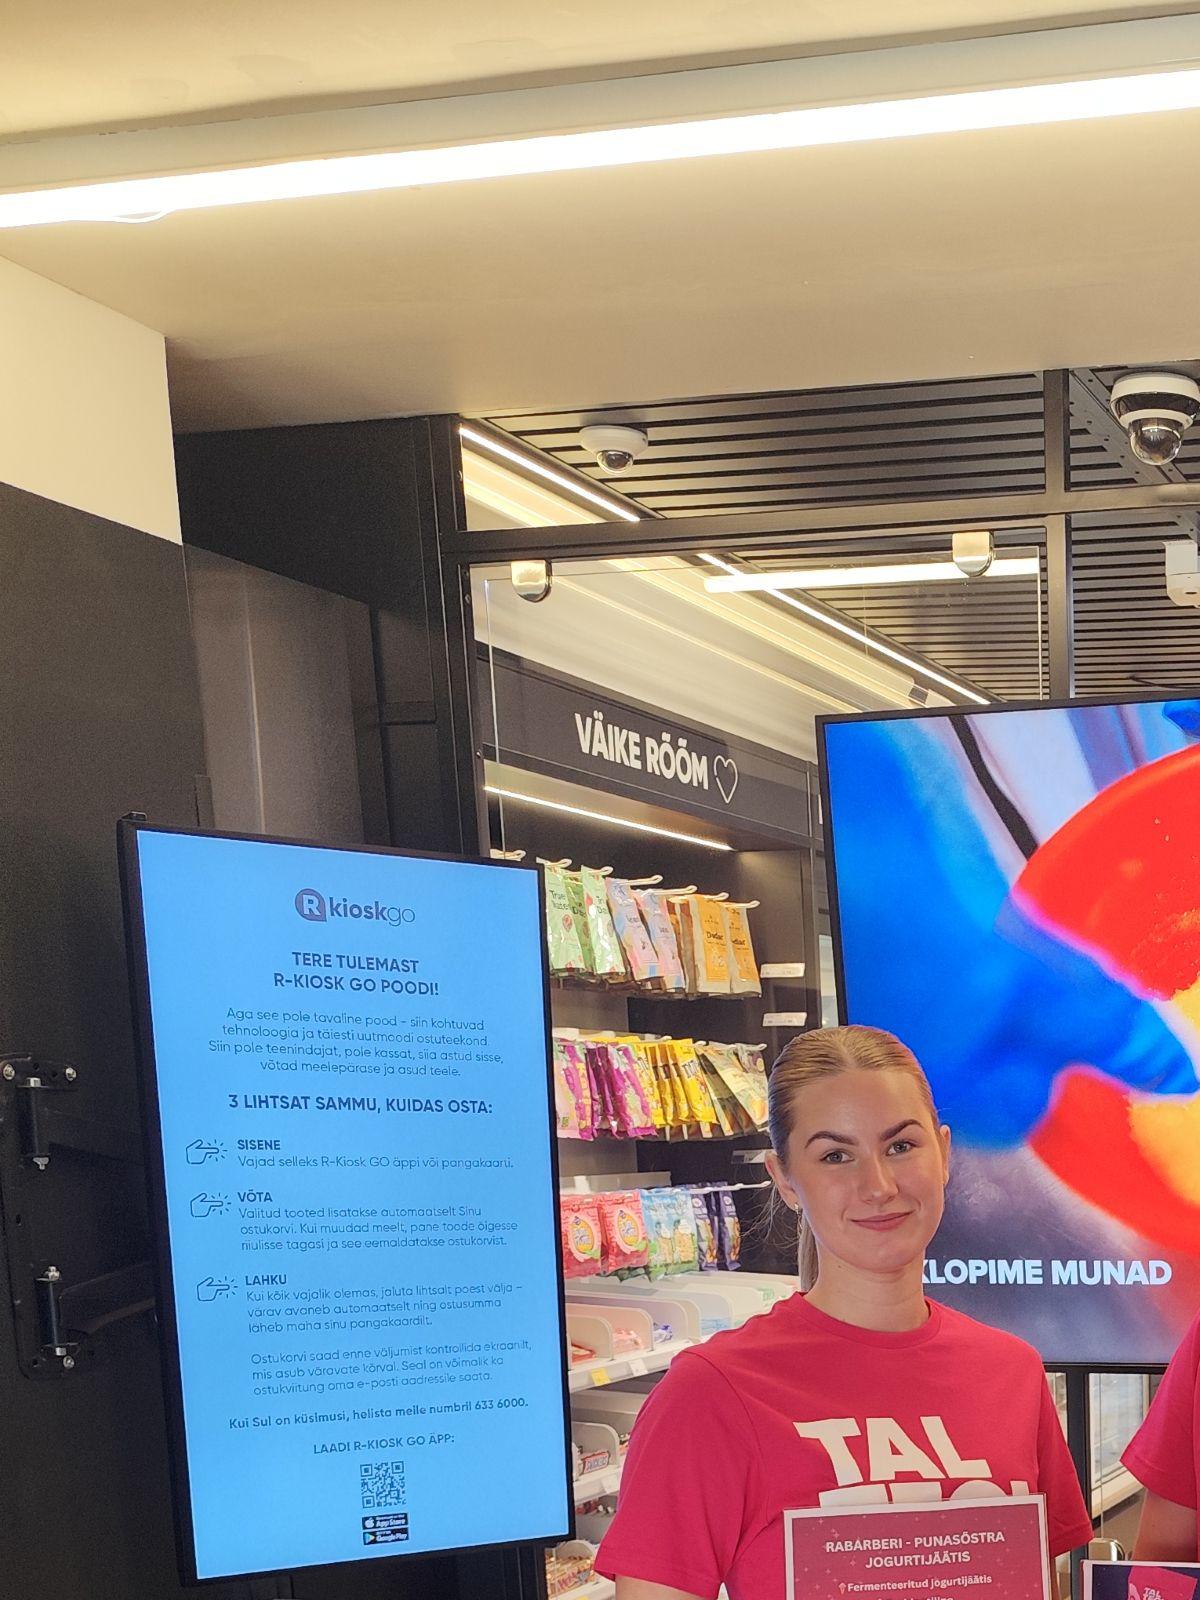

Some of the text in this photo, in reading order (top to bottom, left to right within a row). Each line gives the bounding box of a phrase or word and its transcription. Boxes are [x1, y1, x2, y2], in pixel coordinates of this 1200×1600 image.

[574, 710, 709, 790] VÄIKE RÕÕM
[328, 896, 416, 928] kioskgo
[291, 951, 419, 973] TERE TULEMAST
[273, 972, 439, 996] R-KIOSK GO POODI!
[225, 1007, 484, 1030] Aga see pole tavaline pood siin kohtuvad
[222, 1023, 299, 1041] tehnoloogia
[301, 1027, 315, 1042] ja
[317, 1028, 354, 1040] täiesti
[357, 1029, 414, 1042] uutmoodi
[208, 1040, 231, 1052] Siin
[233, 1041, 263, 1056] pole
[265, 1042, 342, 1059] teenindajat,
[344, 1045, 371, 1060] pole
[373, 1046, 415, 1060] kassat,
[417, 1048, 437, 1059] siia
[439, 1049, 472, 1060] astud
[259, 1058, 461, 1077] võtad meelepärase ja asud teele.
[228, 1094, 493, 1114] 3 LIHTSAT SAMMU, KUIDAS OSTA:
[236, 1139, 281, 1150] SISENE
[238, 1156, 275, 1170] Vajad
[278, 1156, 318, 1167] selleks
[320, 1156, 366, 1167] R-Kiosk
[369, 1156, 389, 1167] GO
[392, 1156, 420, 1170] äppi
[421, 1157, 439, 1167] või
[236, 1189, 273, 1203] VÕTA
[238, 1207, 281, 1219] Valitud
[283, 1207, 325, 1218] tooted
[327, 1206, 377, 1217] lisatakse
[458, 1205, 481, 1216] Sinu
[299, 1223, 317, 1234] Kui
[319, 1222, 369, 1233] muudad
[409, 1224, 440, 1235] pane
[442, 1221, 475, 1231] toode
[244, 1274, 287, 1286] LAHKU
[1052, 1260, 1172, 1285] MUNAD
[228, 1417, 249, 1429] Kui
[251, 1415, 272, 1427] Sul
[275, 1416, 291, 1426] on
[293, 1409, 350, 1426] küsimusi,
[352, 1406, 392, 1420] helista
[395, 1404, 427, 1417] meile
[429, 1401, 471, 1414] numbril
[474, 1399, 494, 1410] 633
[313, 1430, 454, 1455] LAADI R-KIOSK GO ÄPP:
[793, 1416, 992, 1486] TAL
[825, 1529, 1005, 1553] RABARBERI PUNASÕSTRA
[864, 1549, 971, 1569] JOGURTIJÄÄTIS
[847, 1573, 992, 1592] Fermenteeritud jogurtijäätis
[1144, 1588, 1161, 1598] TAL
